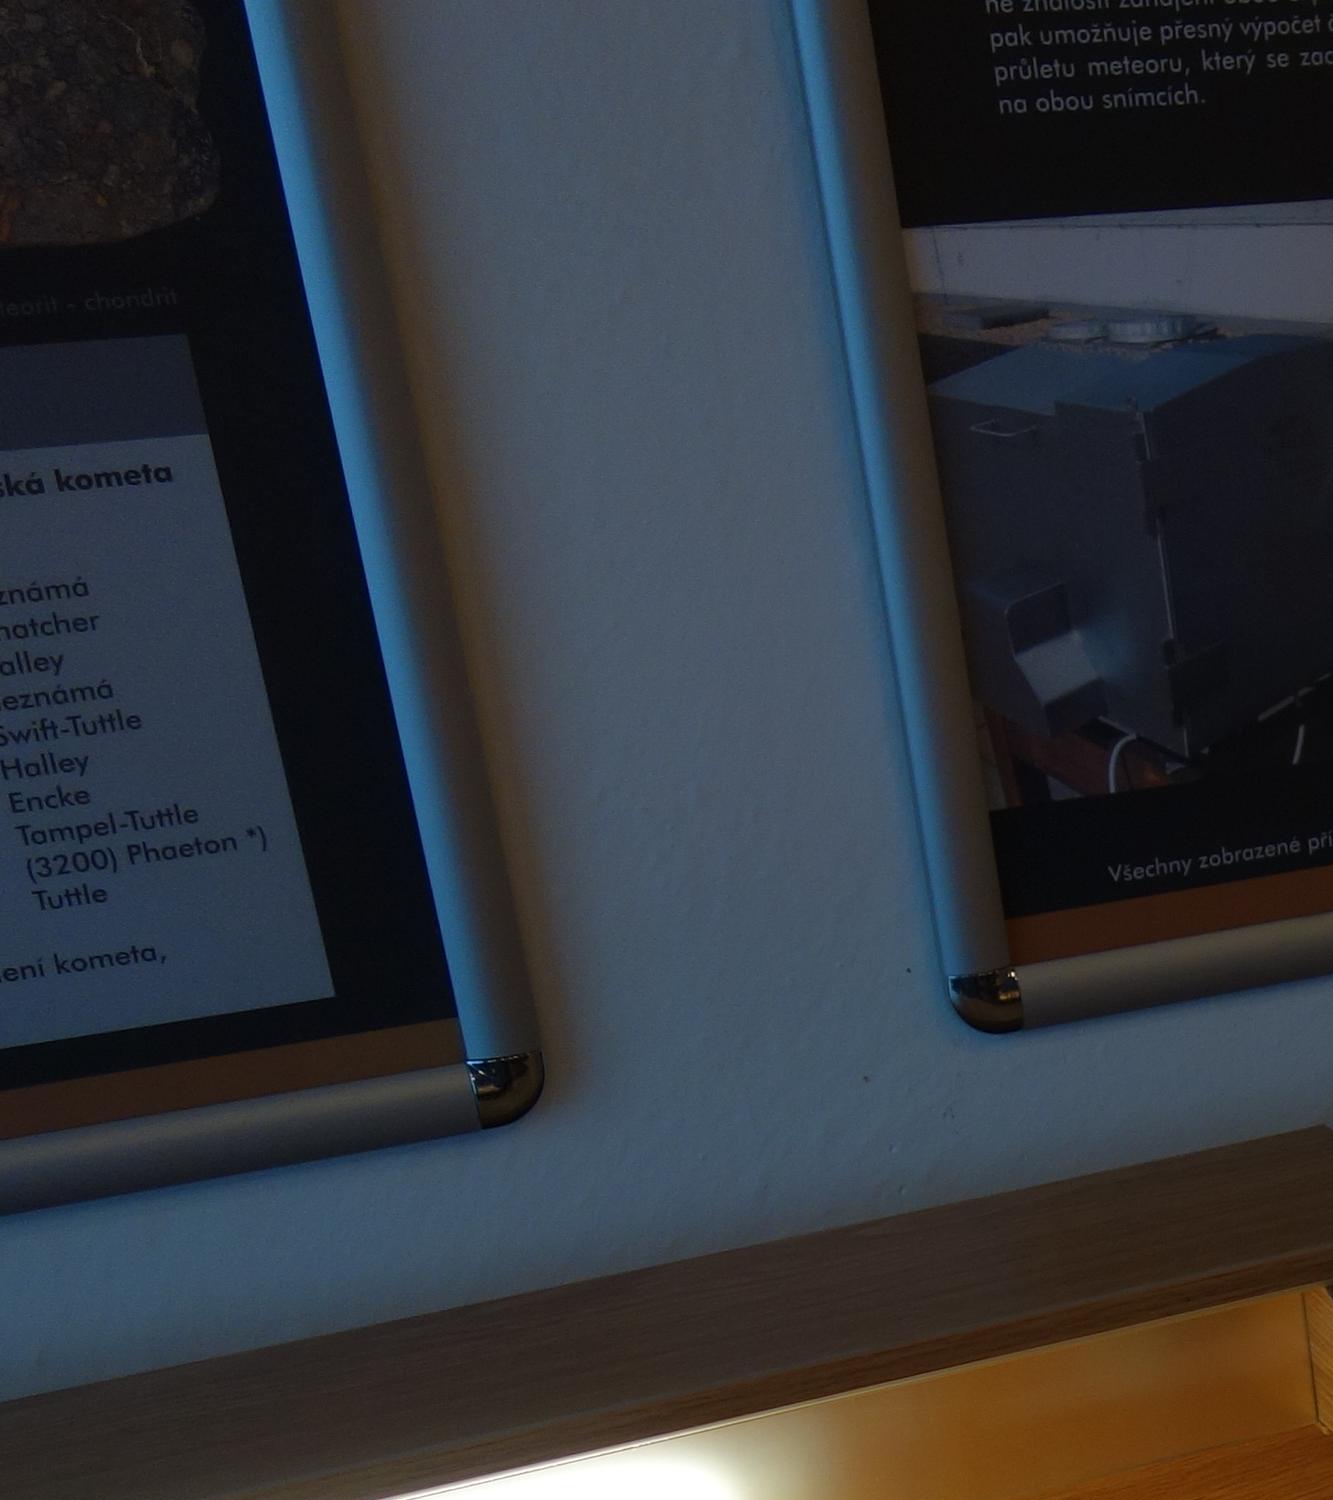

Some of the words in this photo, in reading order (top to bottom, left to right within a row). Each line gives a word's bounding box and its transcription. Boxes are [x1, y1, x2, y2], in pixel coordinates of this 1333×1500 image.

[990, 23, 1032, 53] pak
[1039, 19, 1152, 46] umožňuje
[1159, 17, 1232, 45] přesný
[1239, 14, 1320, 41] výpočet
[994, 56, 1074, 86] průletu
[1087, 55, 1189, 75] meteoru,
[1200, 48, 1255, 74] který
[1266, 52, 1289, 68] se
[999, 98, 1027, 113] na
[1035, 89, 1093, 112] obou
[1102, 82, 1205, 108] snímcích.
[83, 287, 176, 312] chondrit
[53, 463, 172, 492] kometa
[0, 751, 88, 780] Halley
[7, 785, 90, 813] Encke
[16, 803, 198, 845] Tampel-Tuttle
[26, 847, 117, 882] (3200)
[126, 836, 237, 864] Phaeton
[1107, 856, 1192, 879] Všechny
[1198, 836, 1300, 865] zobrazené
[32, 883, 107, 910] Tuttle
[53, 945, 166, 974] kometa,
